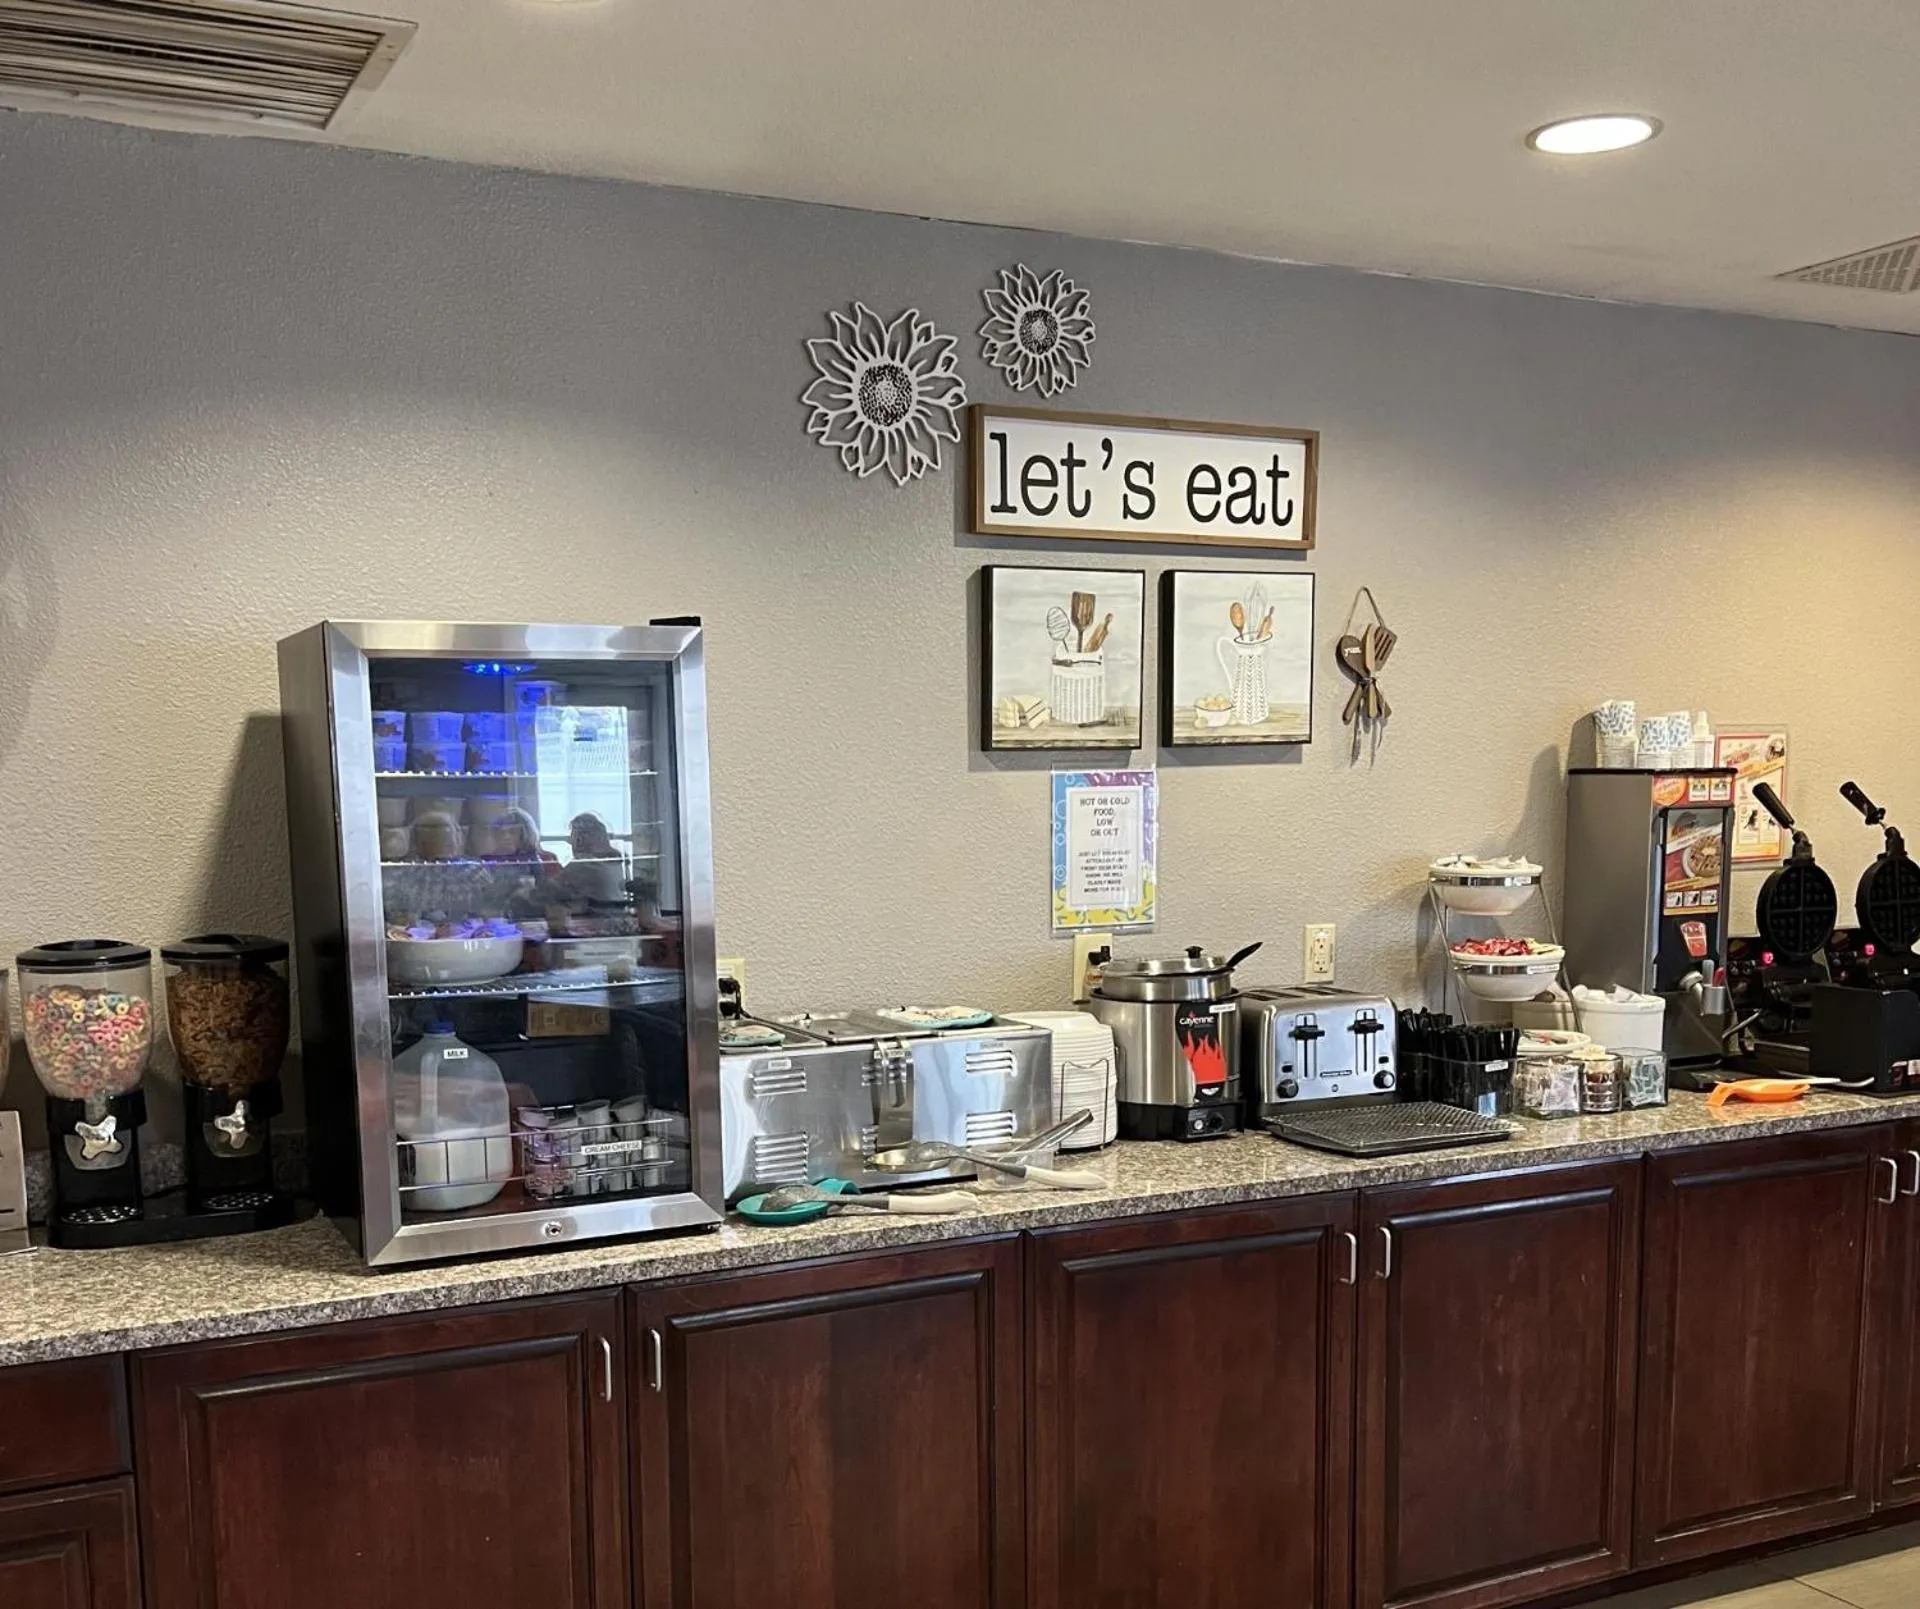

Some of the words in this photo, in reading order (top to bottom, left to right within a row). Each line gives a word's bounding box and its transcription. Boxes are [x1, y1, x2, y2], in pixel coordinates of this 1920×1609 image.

[989, 432, 1156, 521] let's
[1187, 454, 1293, 527] eat
[1080, 798, 1095, 806] HOT
[1110, 797, 1130, 805] COLD
[1179, 1016, 1214, 1027] cayenne
[447, 1050, 464, 1058] MILK
[584, 1145, 611, 1154] CREAM
[612, 1141, 640, 1151] CHEESE
